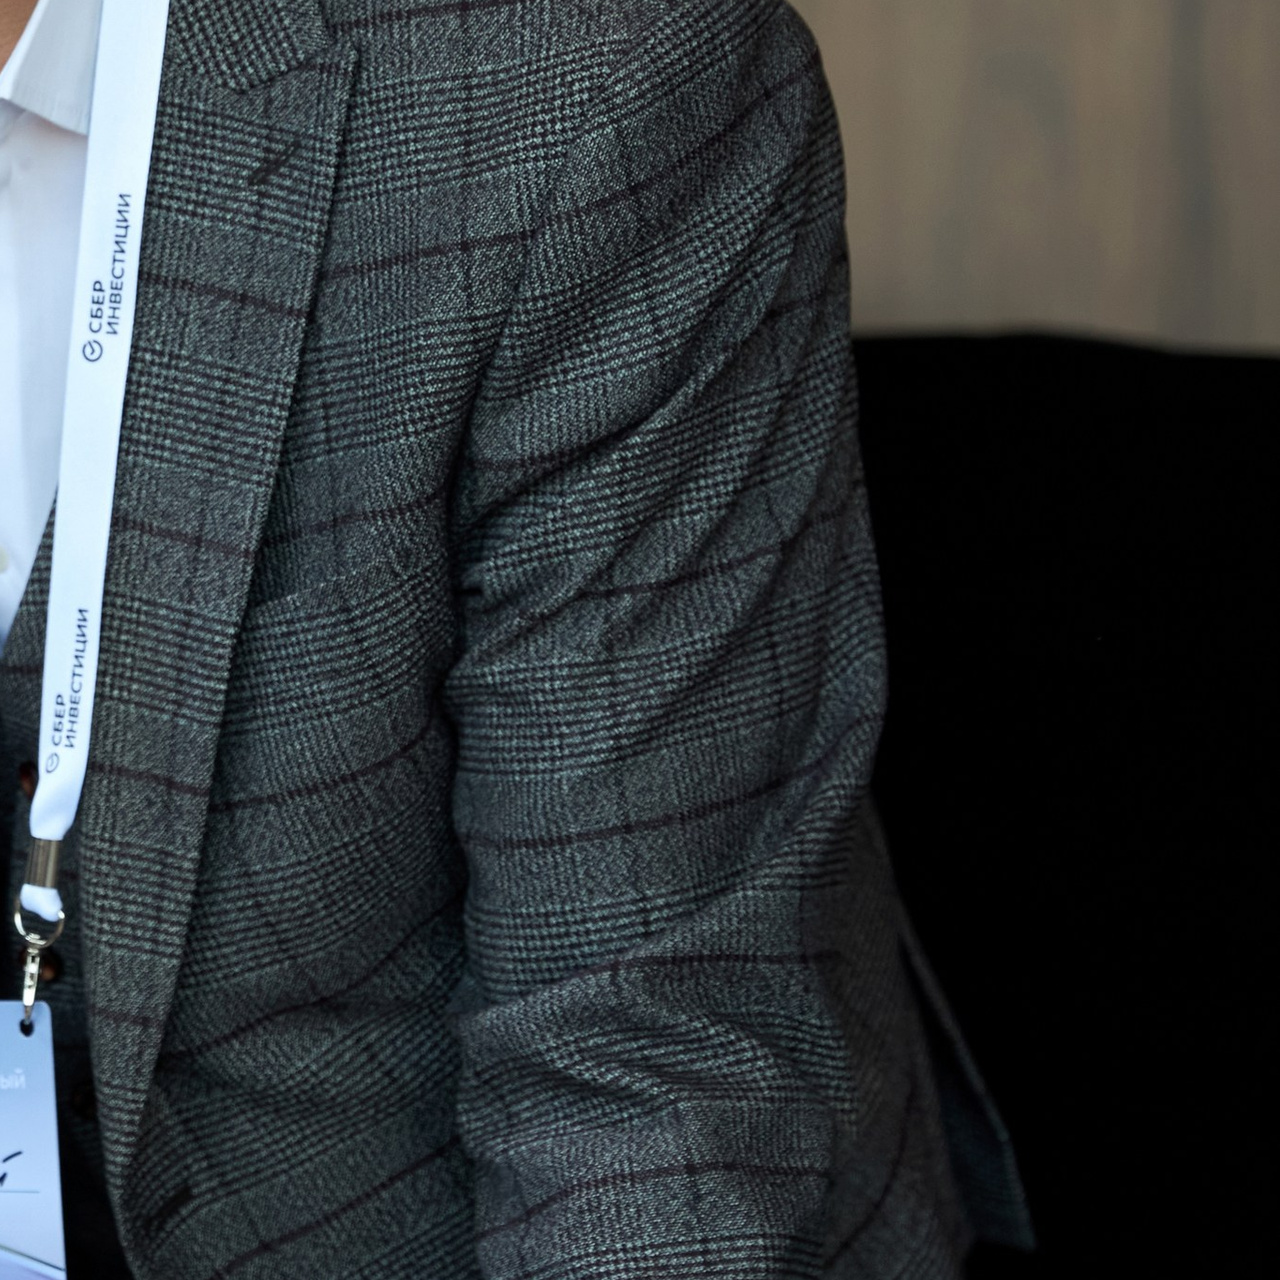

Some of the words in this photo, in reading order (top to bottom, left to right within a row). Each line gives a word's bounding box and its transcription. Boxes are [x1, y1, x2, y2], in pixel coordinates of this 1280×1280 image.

[89, 280, 106, 333] СБЕР
[106, 193, 132, 335] ИНВЕСТИЦИИ
[52, 693, 66, 746] СБЕР
[65, 608, 89, 748] ИНВЕСТИЦИИ
